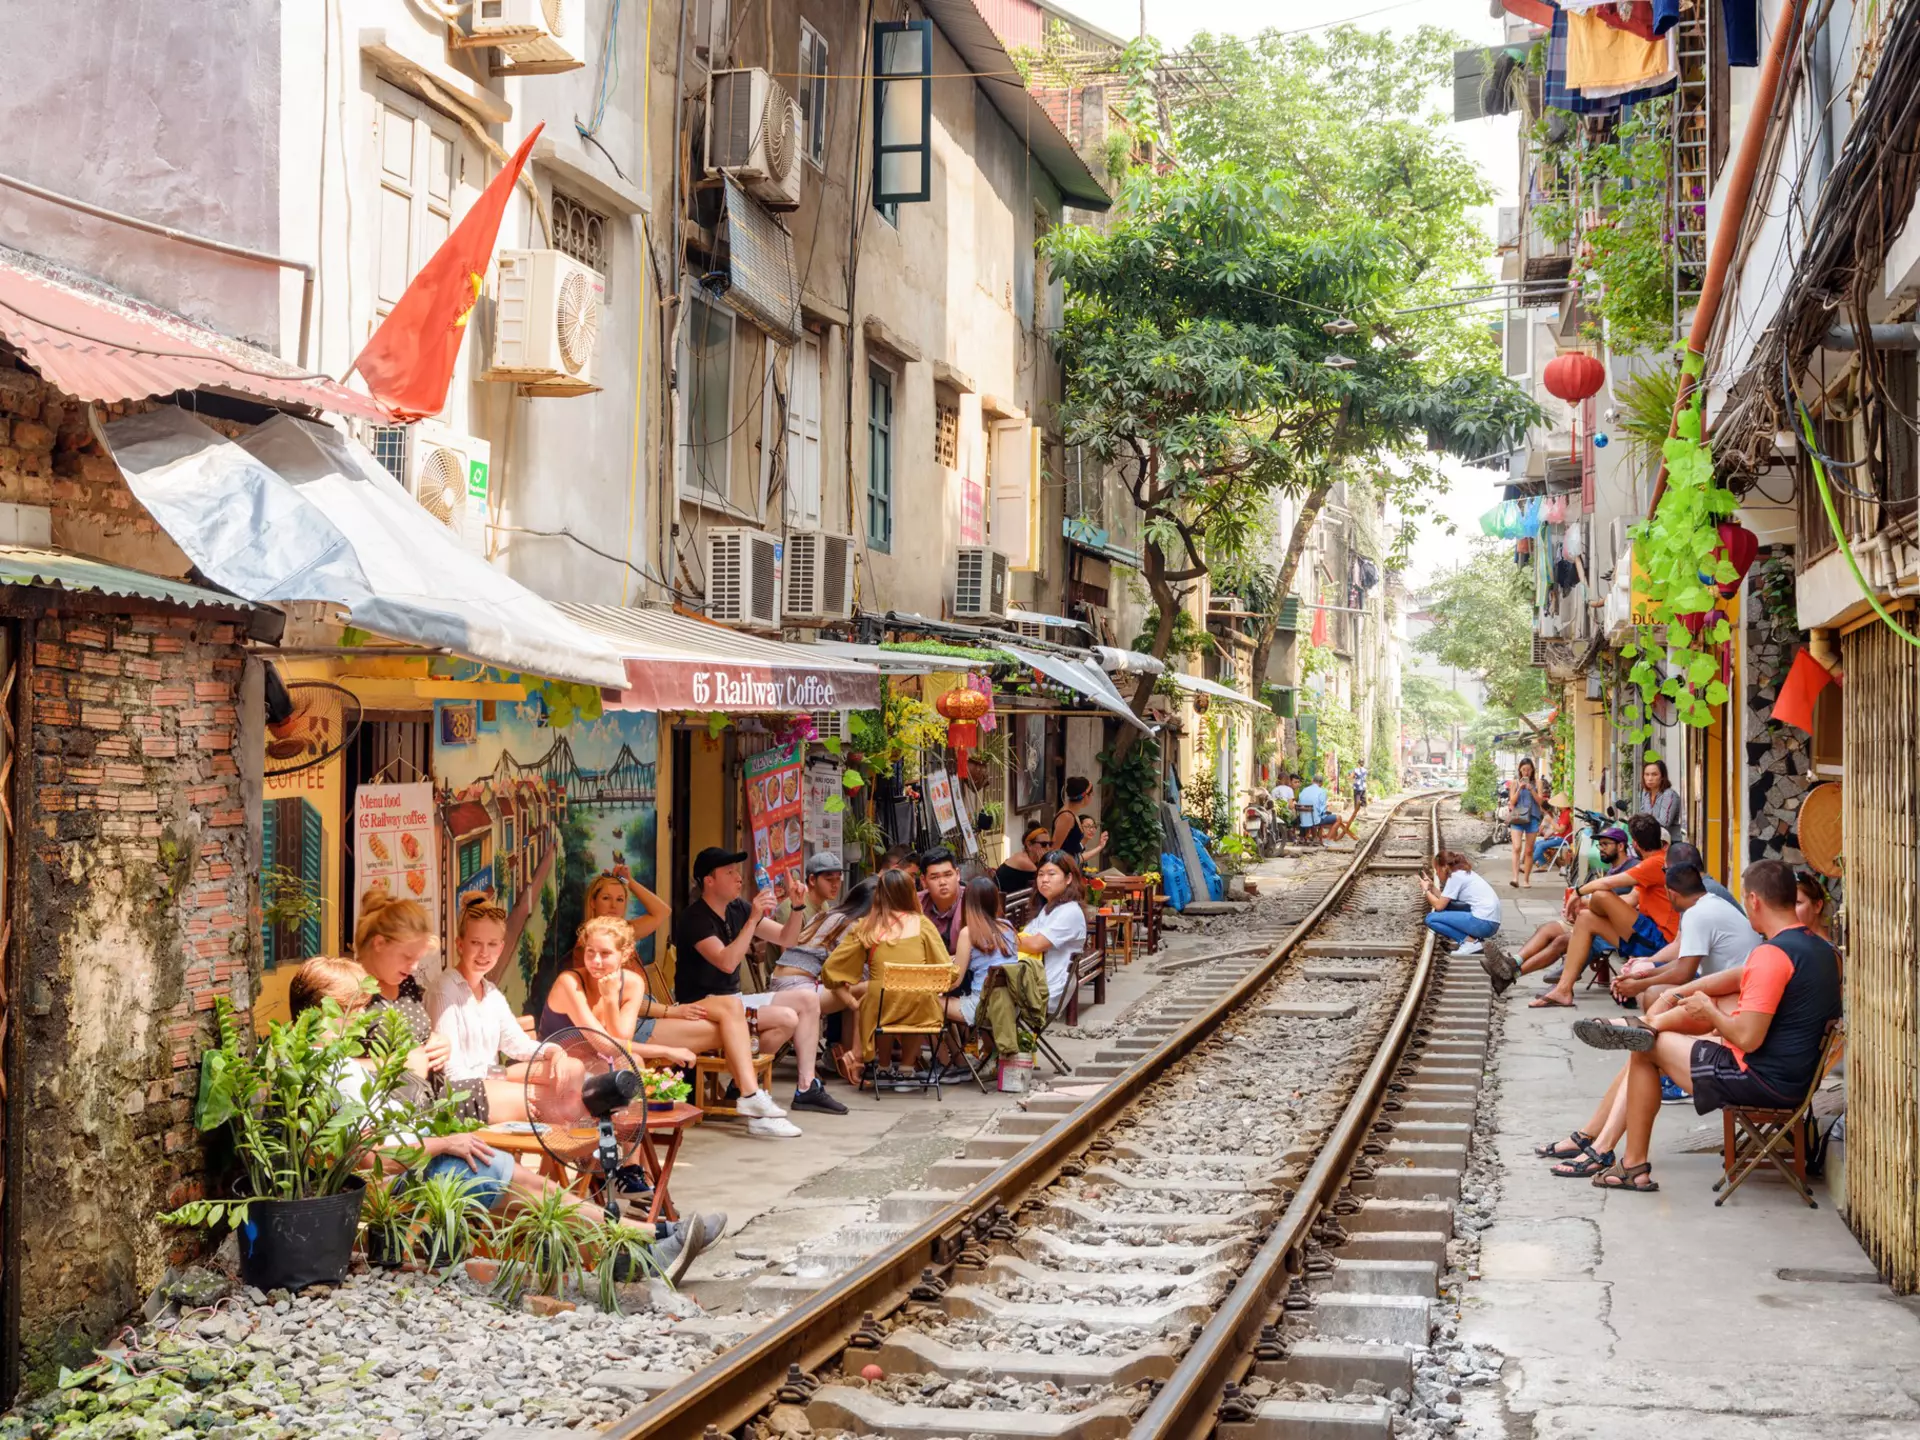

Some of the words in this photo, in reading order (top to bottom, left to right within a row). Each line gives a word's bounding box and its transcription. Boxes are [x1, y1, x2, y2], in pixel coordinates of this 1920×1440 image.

[692, 672, 710, 704] 65
[714, 671, 784, 711] Railway
[787, 675, 834, 706] Coffee
[360, 794, 383, 809] Menu
[384, 793, 401, 808] food
[359, 813, 369, 829] 65
[370, 812, 401, 829] Railway
[403, 810, 427, 825] coffee
